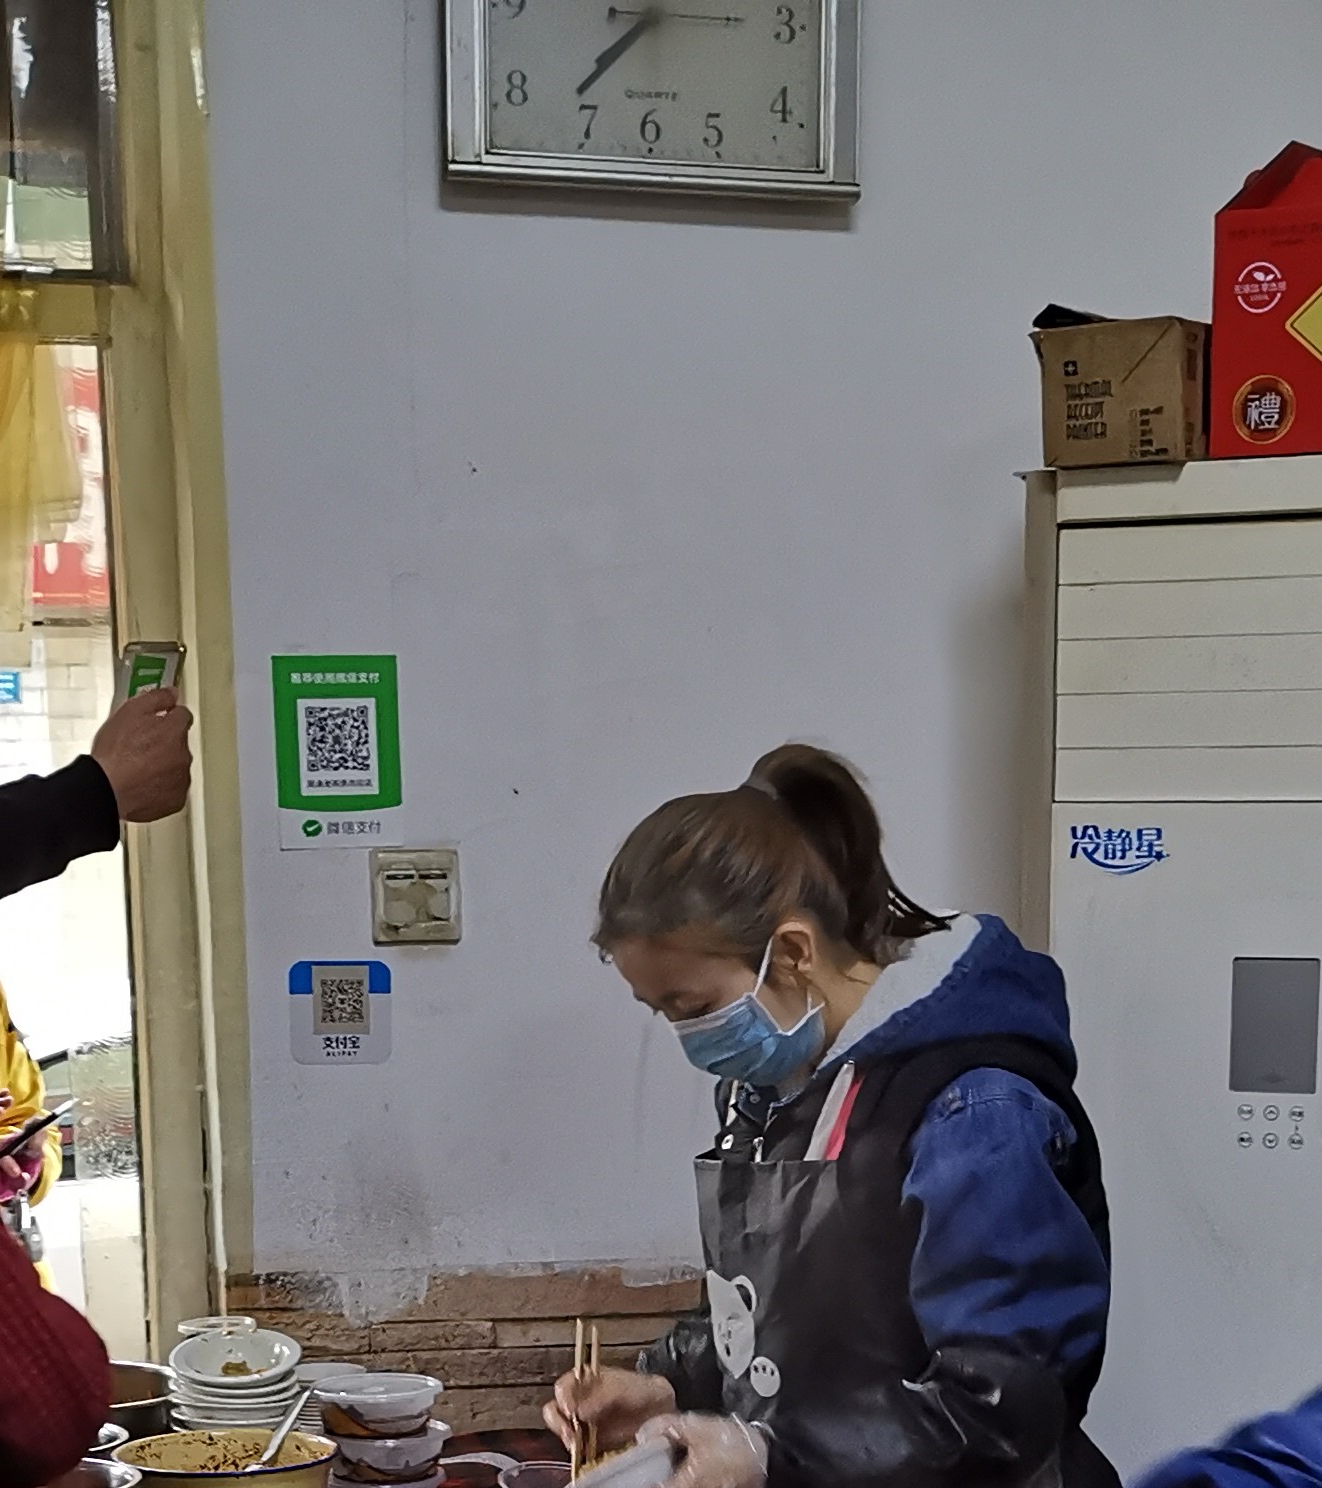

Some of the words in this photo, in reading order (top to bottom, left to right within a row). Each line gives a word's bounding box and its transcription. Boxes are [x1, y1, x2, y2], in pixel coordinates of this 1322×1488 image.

[774, 7, 797, 44] 3
[505, 69, 529, 106] 8
[769, 86, 794, 123] 4
[578, 104, 598, 140] 7
[639, 108, 662, 144] 6
[702, 112, 724, 149] 5
[1069, 824, 1166, 866] 冷静星
[322, 1035, 361, 1050] 支付宝
